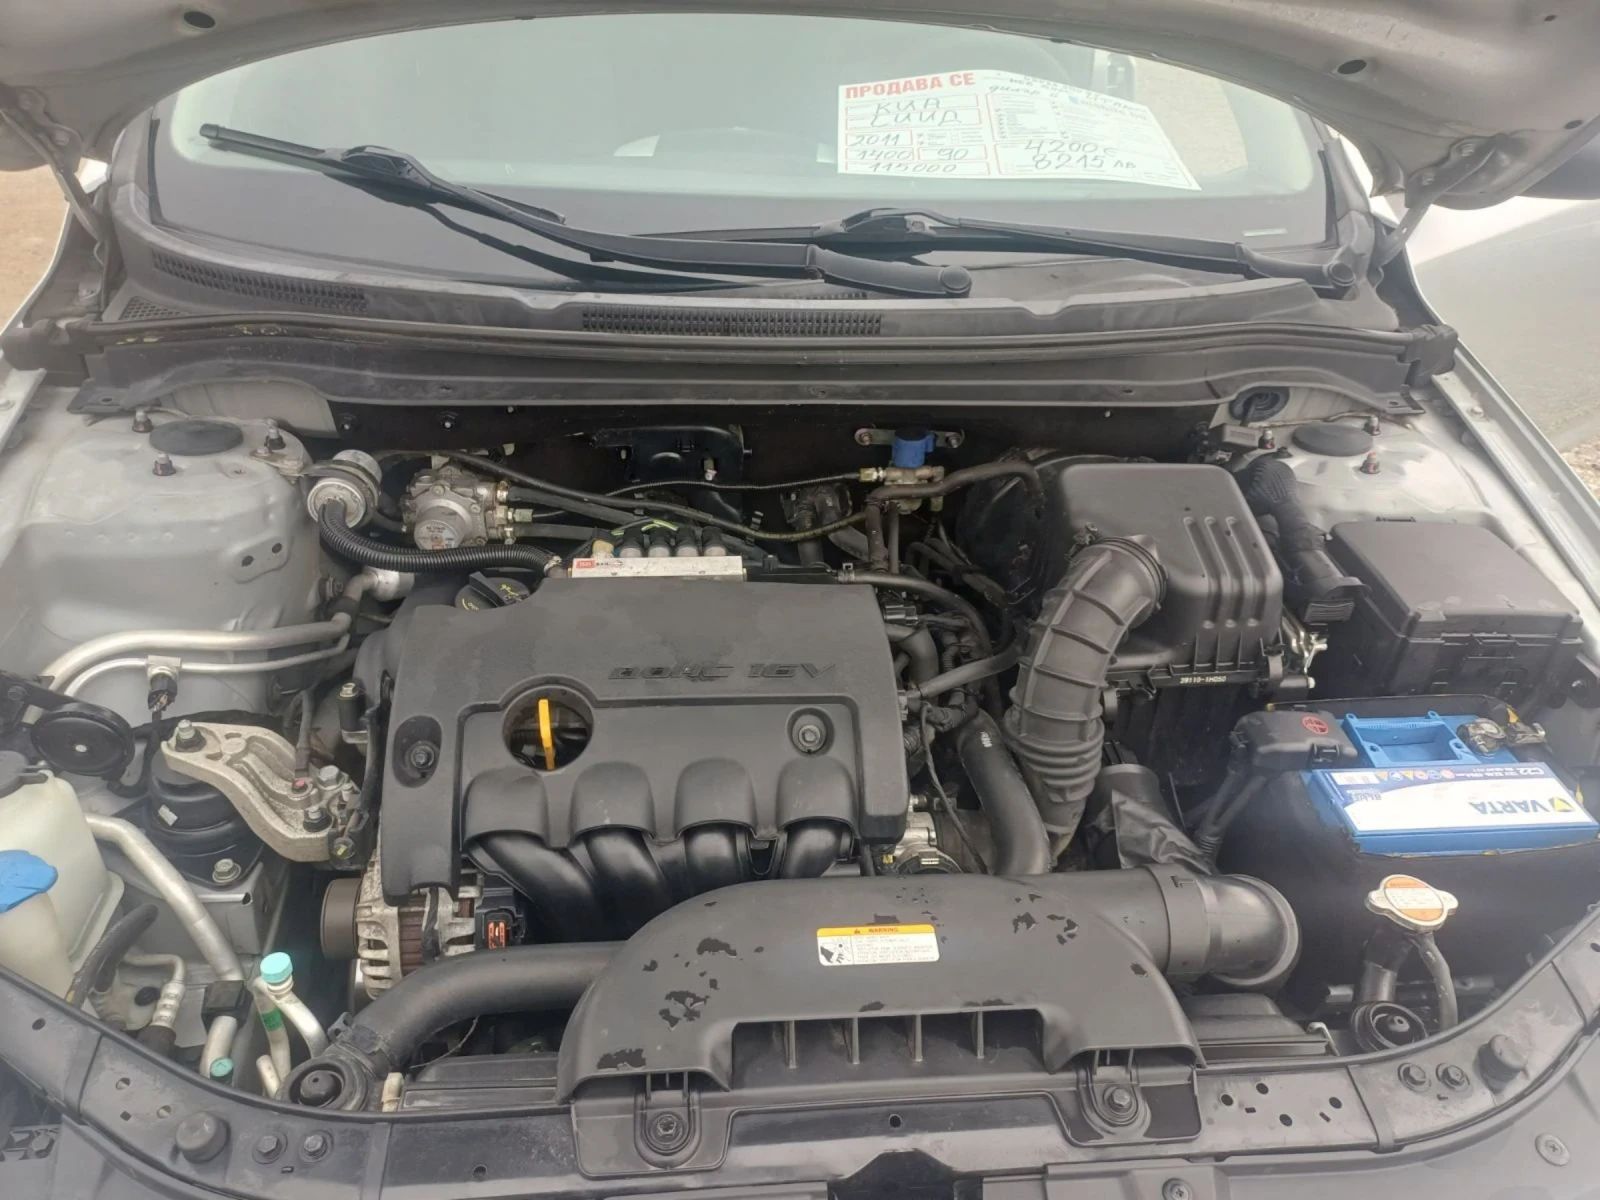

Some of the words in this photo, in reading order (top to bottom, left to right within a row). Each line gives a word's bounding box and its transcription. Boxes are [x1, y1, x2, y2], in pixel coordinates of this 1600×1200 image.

[846, 76, 942, 99] ПРОДАВА
[949, 72, 975, 87] СЕ
[849, 133, 901, 147] 2011
[1024, 139, 1099, 155] 4200
[858, 149, 913, 160] 1400
[937, 148, 969, 160] 90
[1032, 153, 1105, 170] 8215
[748, 662, 837, 679] 16V
[1468, 799, 1551, 815] VARTA
